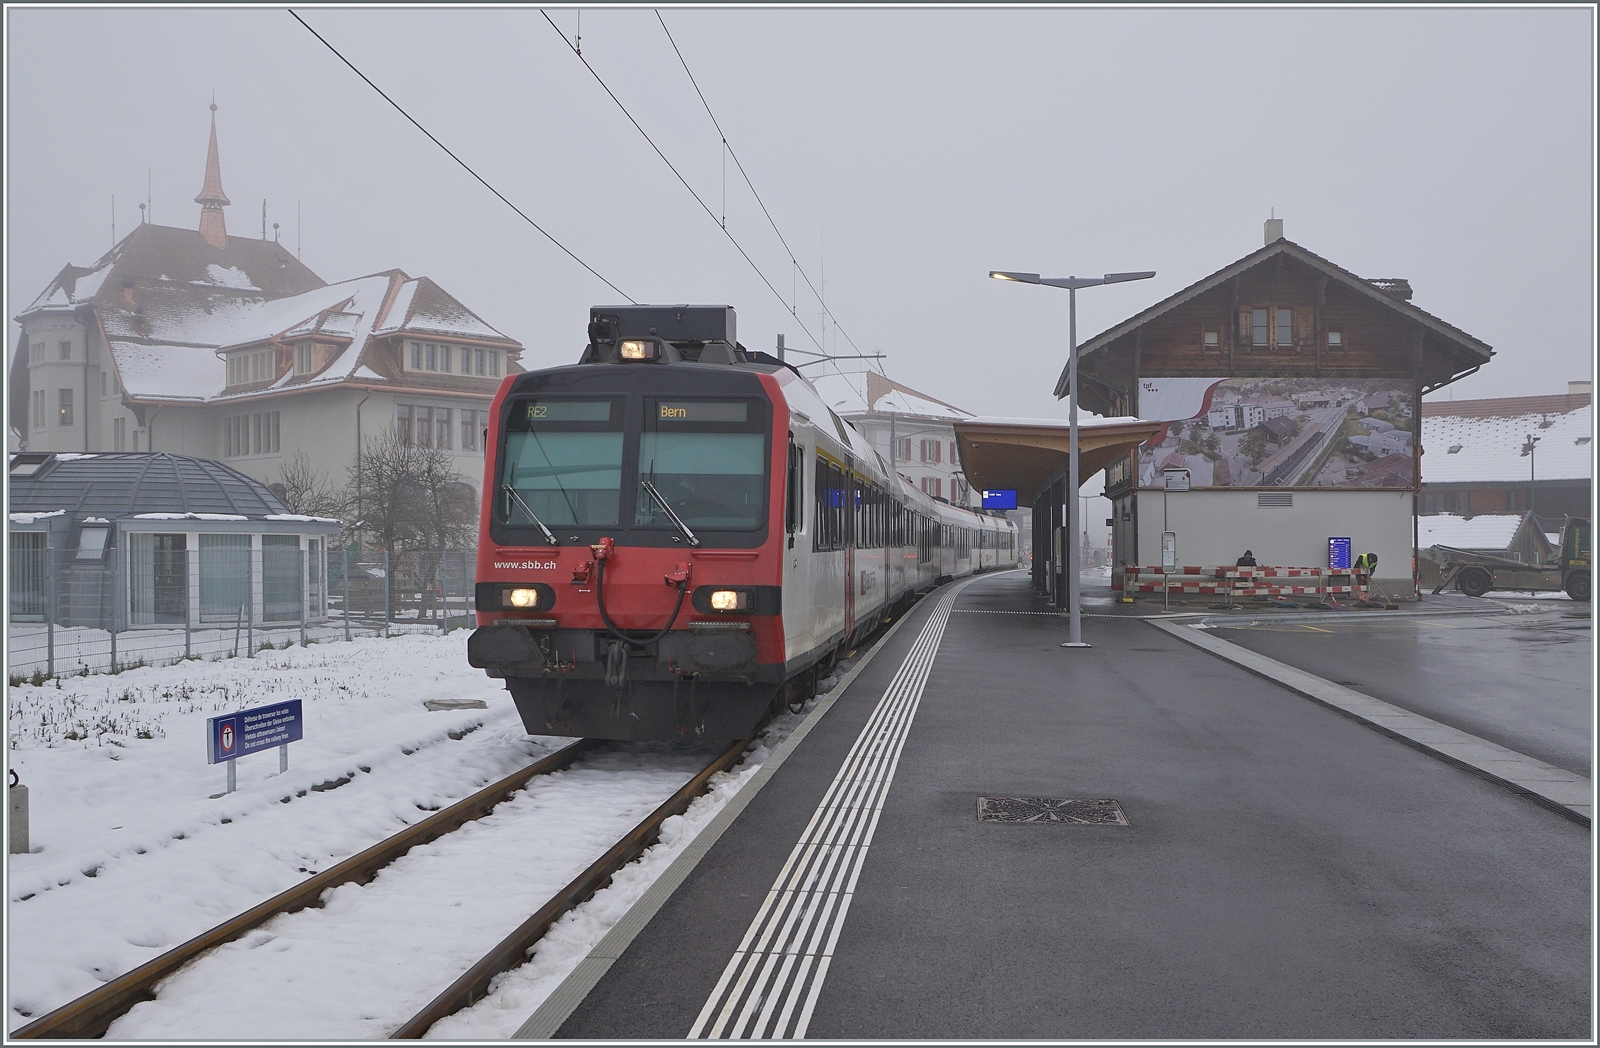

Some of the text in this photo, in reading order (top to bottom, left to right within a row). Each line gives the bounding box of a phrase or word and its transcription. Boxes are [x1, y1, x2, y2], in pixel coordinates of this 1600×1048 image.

[527, 406, 547, 418] RE2
[660, 405, 686, 418] Bern
[494, 561, 556, 570] www.sbb.ch
[256, 728, 275, 738] attraversare
